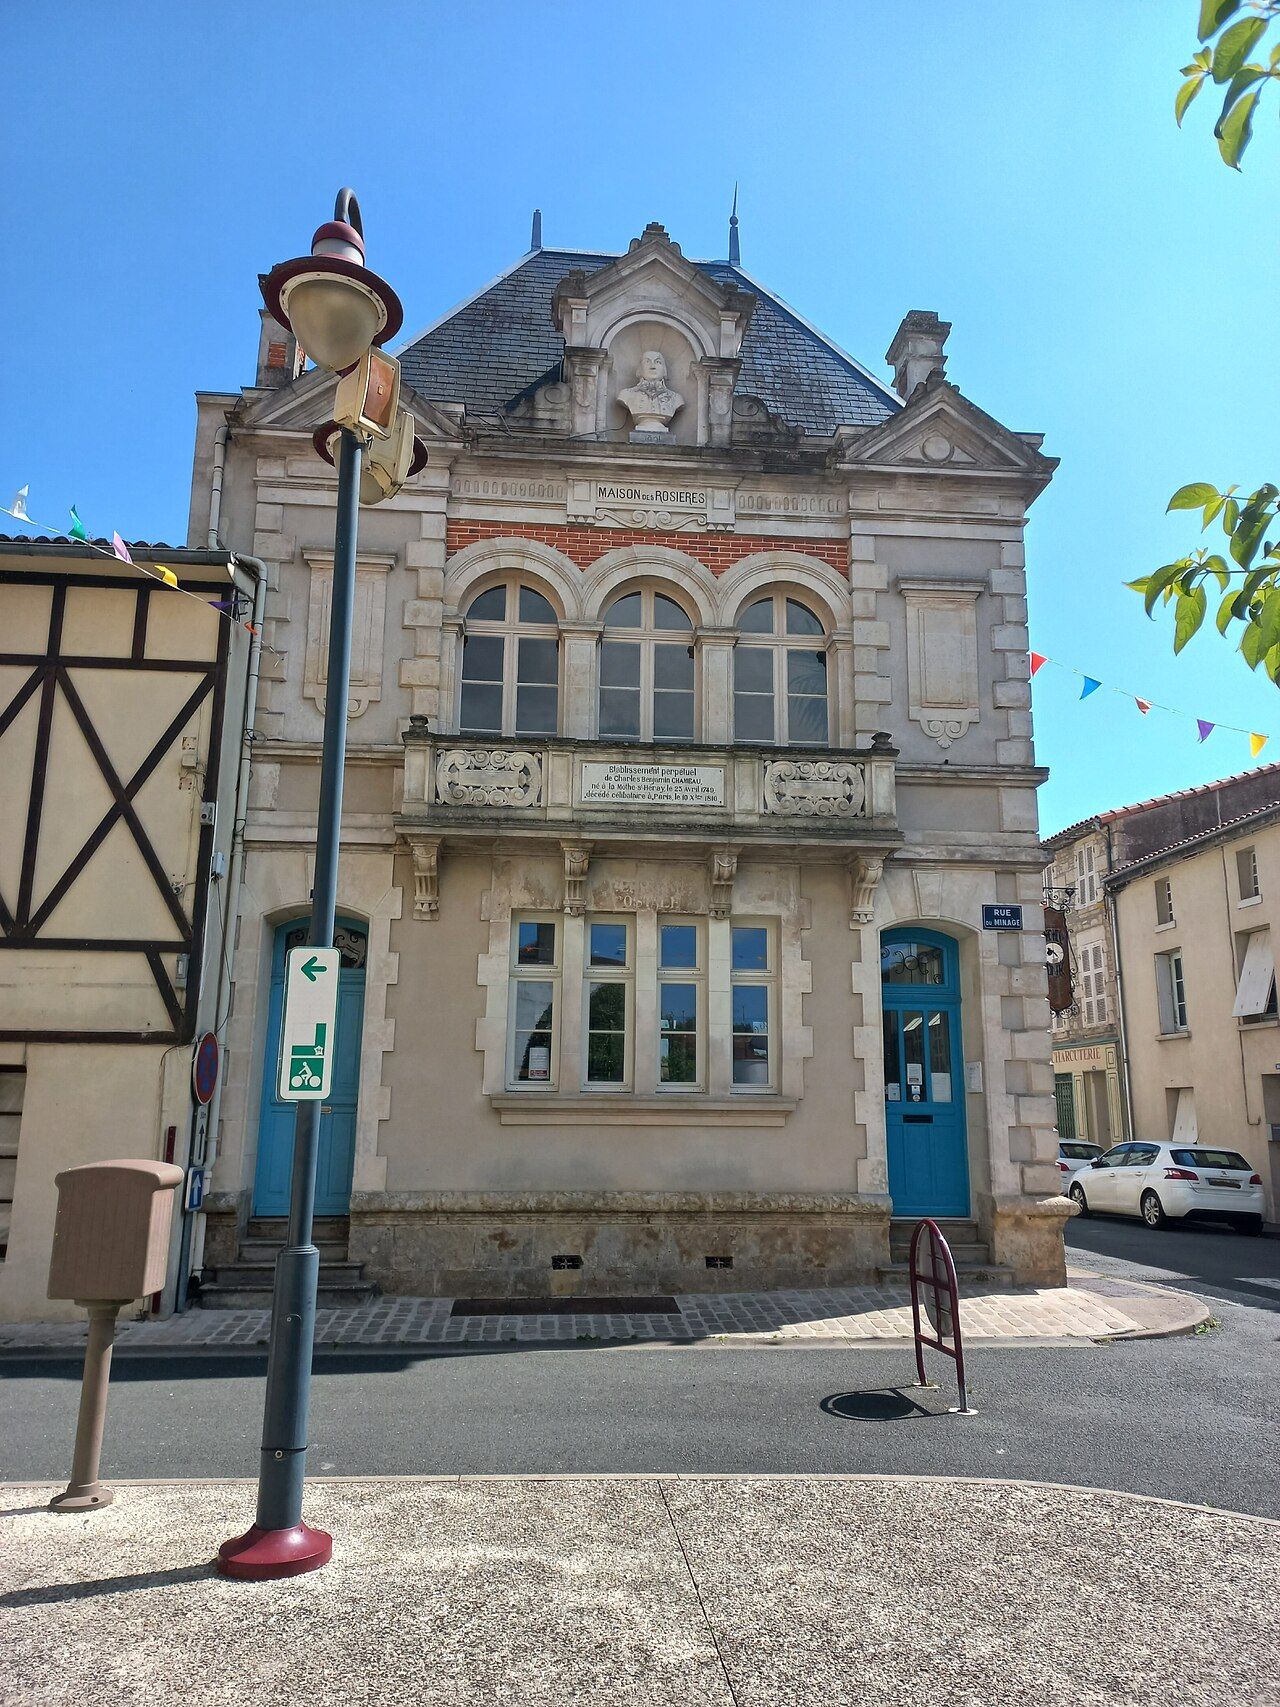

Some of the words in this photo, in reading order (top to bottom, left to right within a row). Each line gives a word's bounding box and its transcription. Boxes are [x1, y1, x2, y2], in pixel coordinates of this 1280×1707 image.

[598, 487, 641, 500] MAISON
[642, 493, 655, 501] DES
[655, 490, 705, 505] ROSIERES
[604, 774, 613, 782] de
[614, 774, 641, 783] Charles
[591, 782, 600, 790] né
[666, 784, 673, 792] le
[674, 793, 681, 801] le
[994, 909, 1011, 917] RUE
[994, 919, 1021, 927] MINAGE
